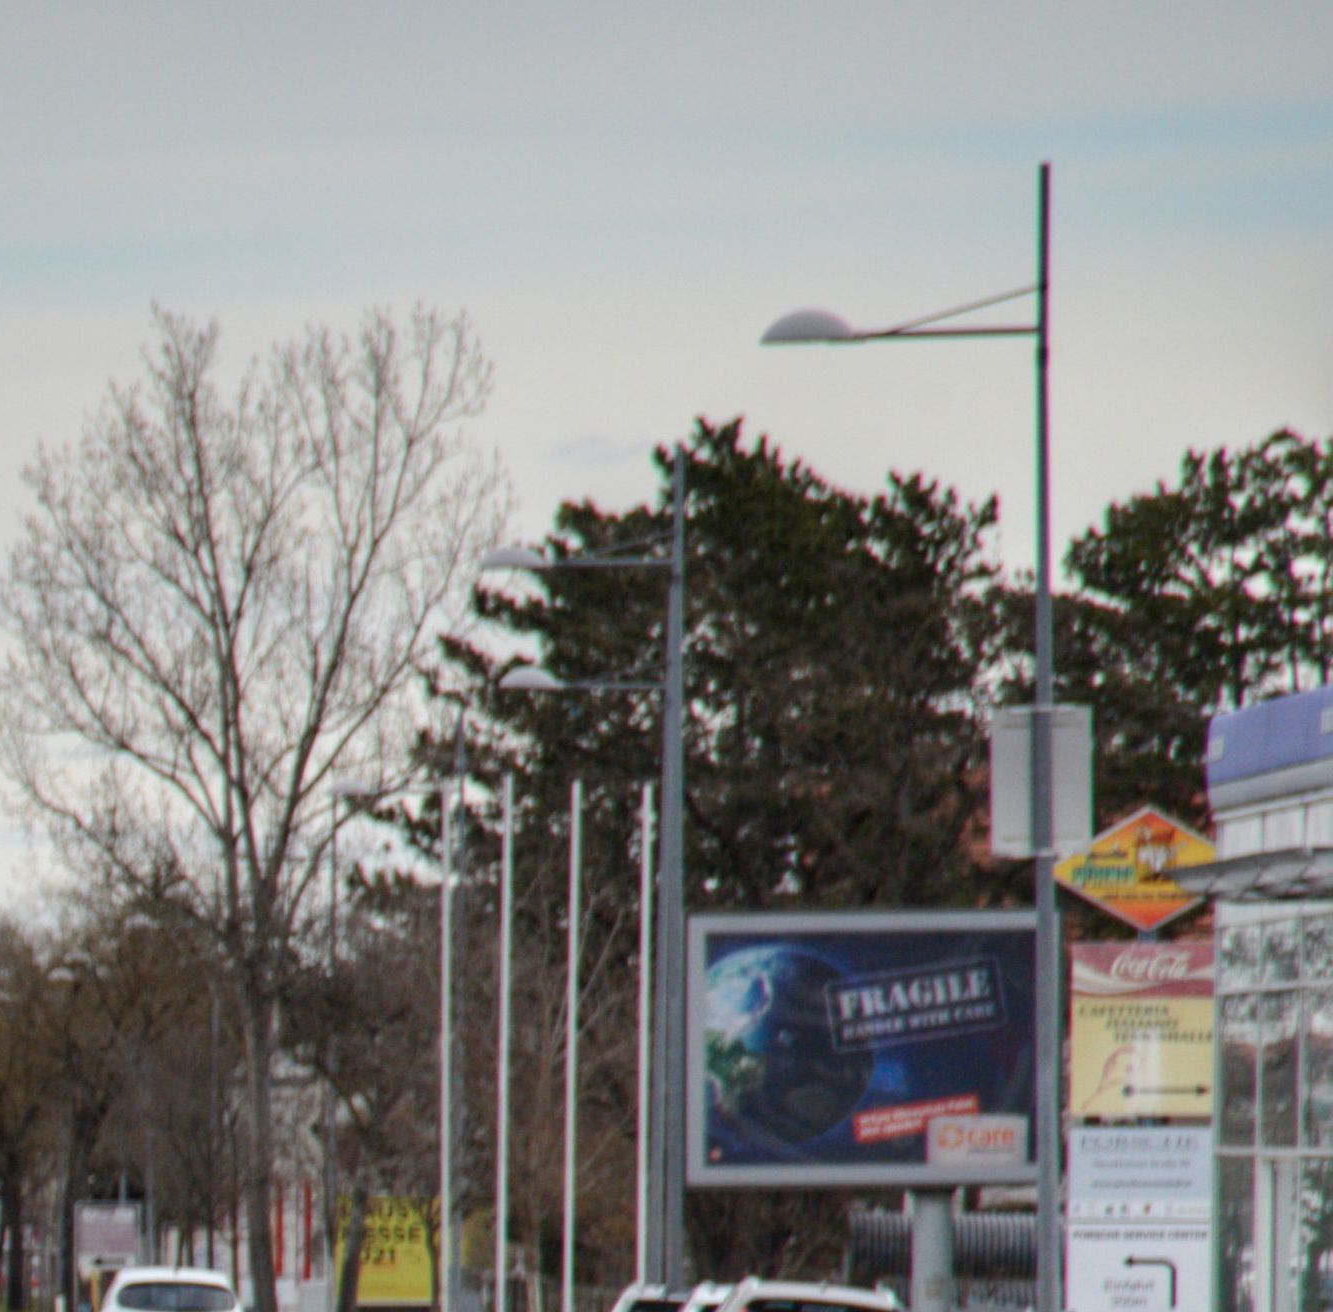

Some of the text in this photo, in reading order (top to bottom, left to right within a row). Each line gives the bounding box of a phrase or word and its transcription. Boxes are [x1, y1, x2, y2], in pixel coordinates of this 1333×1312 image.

[838, 968, 989, 1020] FRAGILE
[843, 1001, 996, 1040] HANDLE WITH CARE
[967, 1127, 1015, 1149] care
